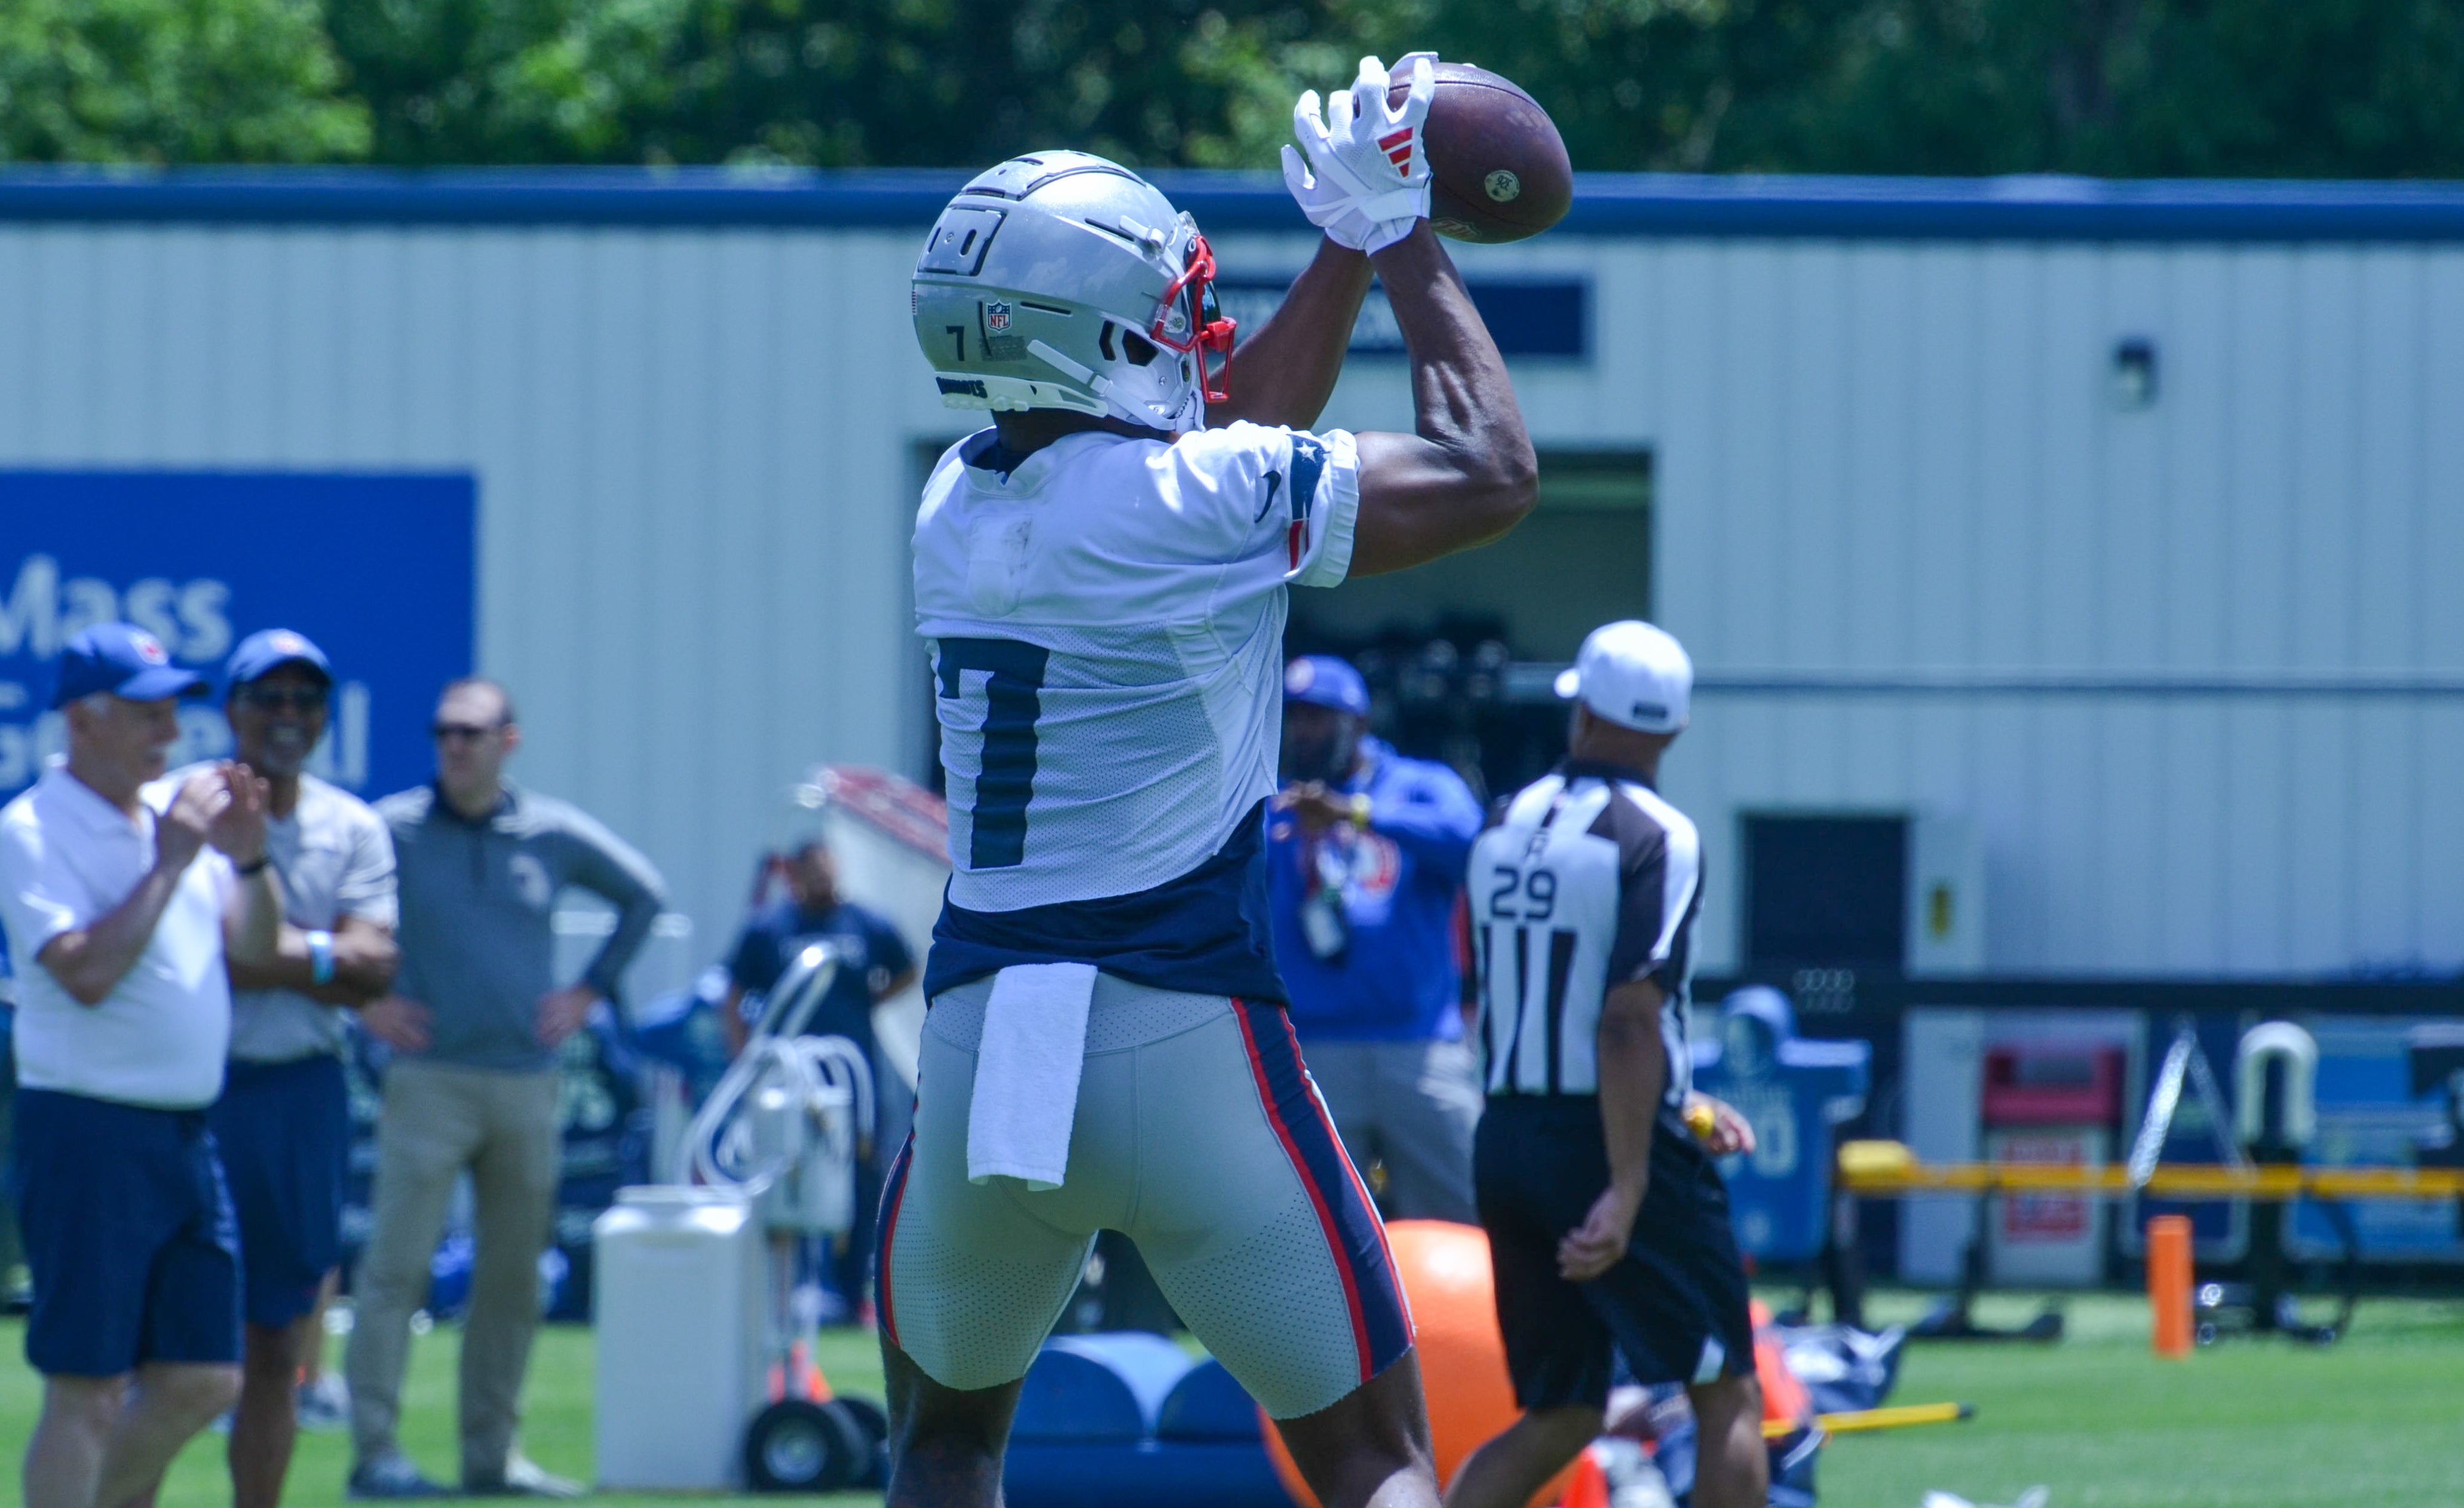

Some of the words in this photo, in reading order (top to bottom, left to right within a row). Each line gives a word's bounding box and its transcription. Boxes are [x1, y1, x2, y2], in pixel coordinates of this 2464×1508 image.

[946, 326, 966, 361] 7
[989, 315, 1009, 328] NFL
[938, 637, 1050, 871] 7
[1490, 866, 1557, 920] 29
